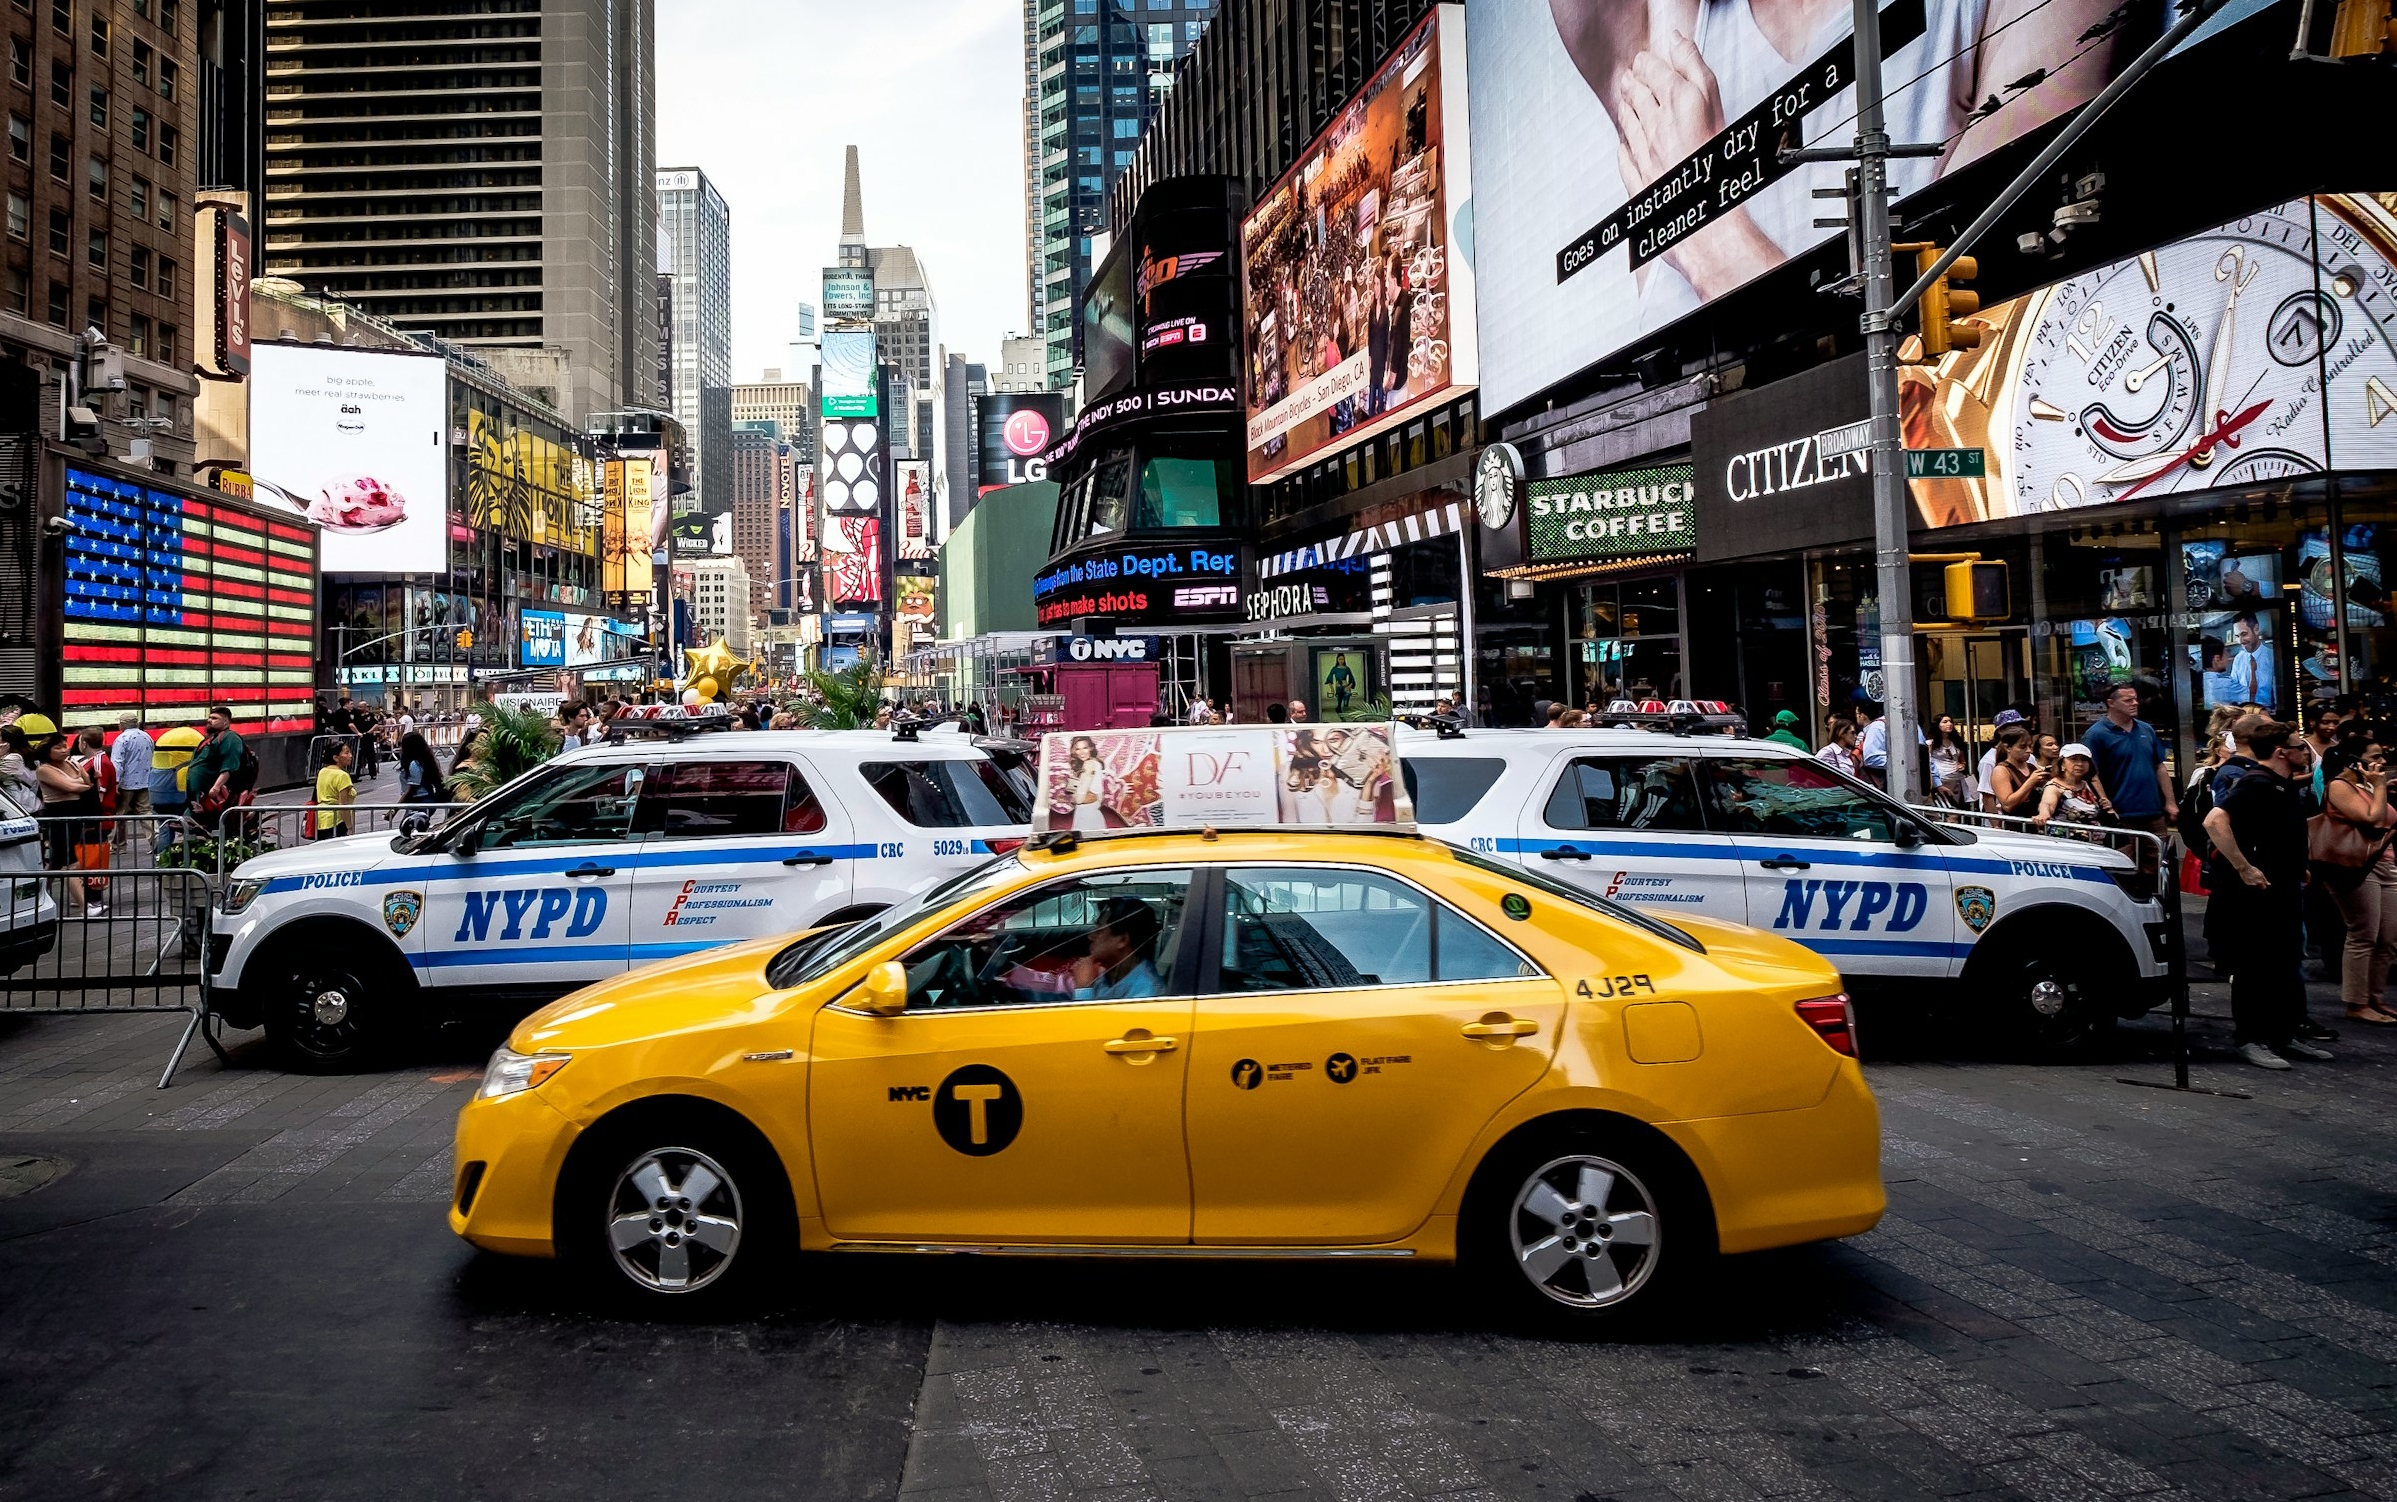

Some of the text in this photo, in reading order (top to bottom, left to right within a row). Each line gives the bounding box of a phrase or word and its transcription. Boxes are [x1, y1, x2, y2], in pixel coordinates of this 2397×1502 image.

[1564, 63, 1839, 271] Goes on instantly dry for a
[1638, 158, 1765, 258] cleaner feel
[2331, 224, 2363, 256] DEL
[828, 283, 870, 291] Johnson &
[2057, 279, 2077, 308] LON
[1171, 318, 1185, 327] LIVE
[1185, 316, 1197, 325] ON
[2065, 301, 2115, 366] 12
[2181, 316, 2202, 340] SMT
[2087, 324, 2134, 386] CITIZEN
[2099, 339, 2139, 392] Eco-Drive
[327, 376, 343, 385] big
[1317, 385, 1330, 402] San
[1331, 373, 1353, 394] Diego,
[1354, 361, 1365, 381] CA
[325, 390, 342, 398] real
[345, 391, 405, 402] strawberries
[1091, 403, 1113, 423] INDY
[1116, 396, 1142, 414] 500
[1157, 388, 1235, 406] SUNDA
[1821, 424, 1870, 456] BROADWAY
[2015, 426, 2023, 451] RIO
[1007, 458, 1047, 484] LG
[1910, 452, 1980, 474] W 43 ST
[222, 477, 253, 499] BUBBA
[780, 452, 790, 508] NOVOTEL
[628, 497, 650, 508] KING
[1566, 511, 1686, 541] COFFEE
[1070, 564, 1083, 583] the
[1085, 559, 1118, 580] State
[1123, 553, 1183, 578] Dept.
[1071, 595, 1095, 615] make
[1098, 591, 1148, 612] shots
[1174, 586, 1238, 606] ESPN
[1247, 583, 1312, 621] SEPHORA
[1094, 639, 1146, 658] NYC
[499, 697, 563, 706] VISIONAIRE
[881, 840, 963, 858] CRC 5029
[1471, 838, 1493, 852] CRC
[304, 872, 361, 889] POLICE
[1612, 871, 1673, 886] COURTESY
[2013, 861, 2071, 879] POLICE
[681, 879, 741, 895] COURTESY
[1605, 886, 1704, 903] PROFESSIONALISM
[454, 886, 608, 942] NYPD
[672, 895, 773, 910] PROFESSIONALISM
[1773, 879, 1928, 932] NYPD
[663, 911, 716, 926] RESPECT
[1576, 974, 1655, 999] 4J29
[888, 1084, 1002, 1144] NYC T
